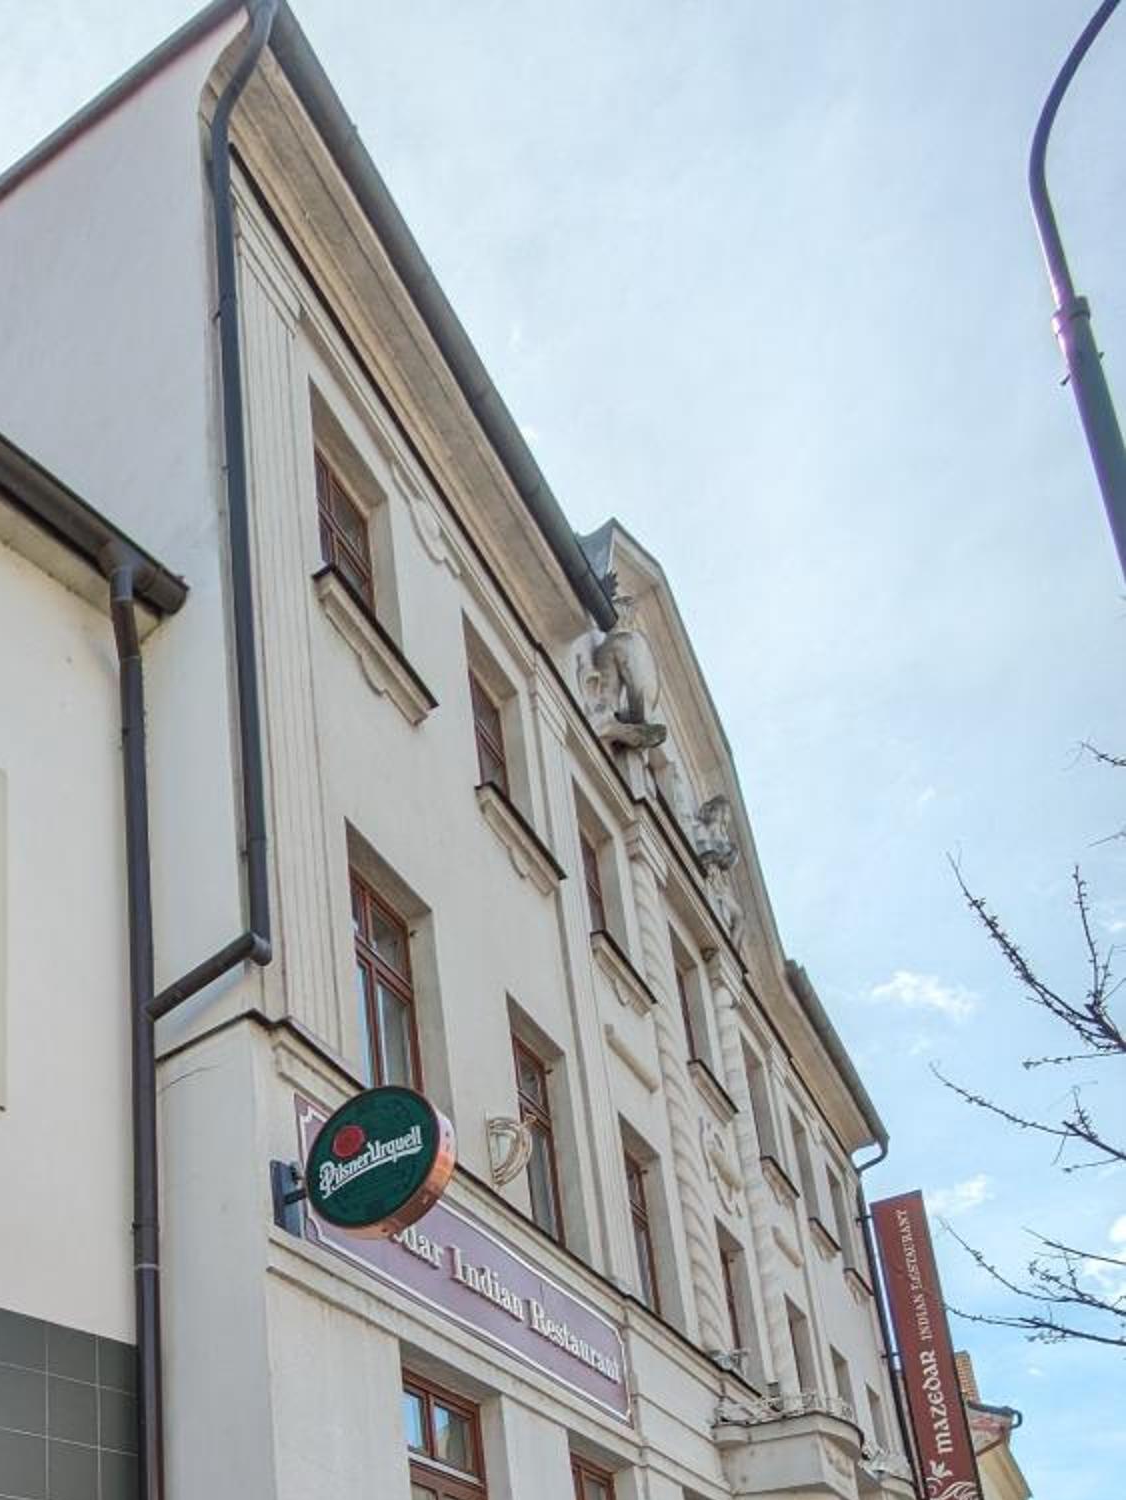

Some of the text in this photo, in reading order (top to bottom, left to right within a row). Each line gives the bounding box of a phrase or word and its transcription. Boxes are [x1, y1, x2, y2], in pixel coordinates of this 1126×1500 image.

[319, 1125, 422, 1199] Pilsner Urquell
[449, 1244, 525, 1323] Indian
[528, 1298, 621, 1385] Restaurant
[914, 1293, 933, 1341] INDIAN
